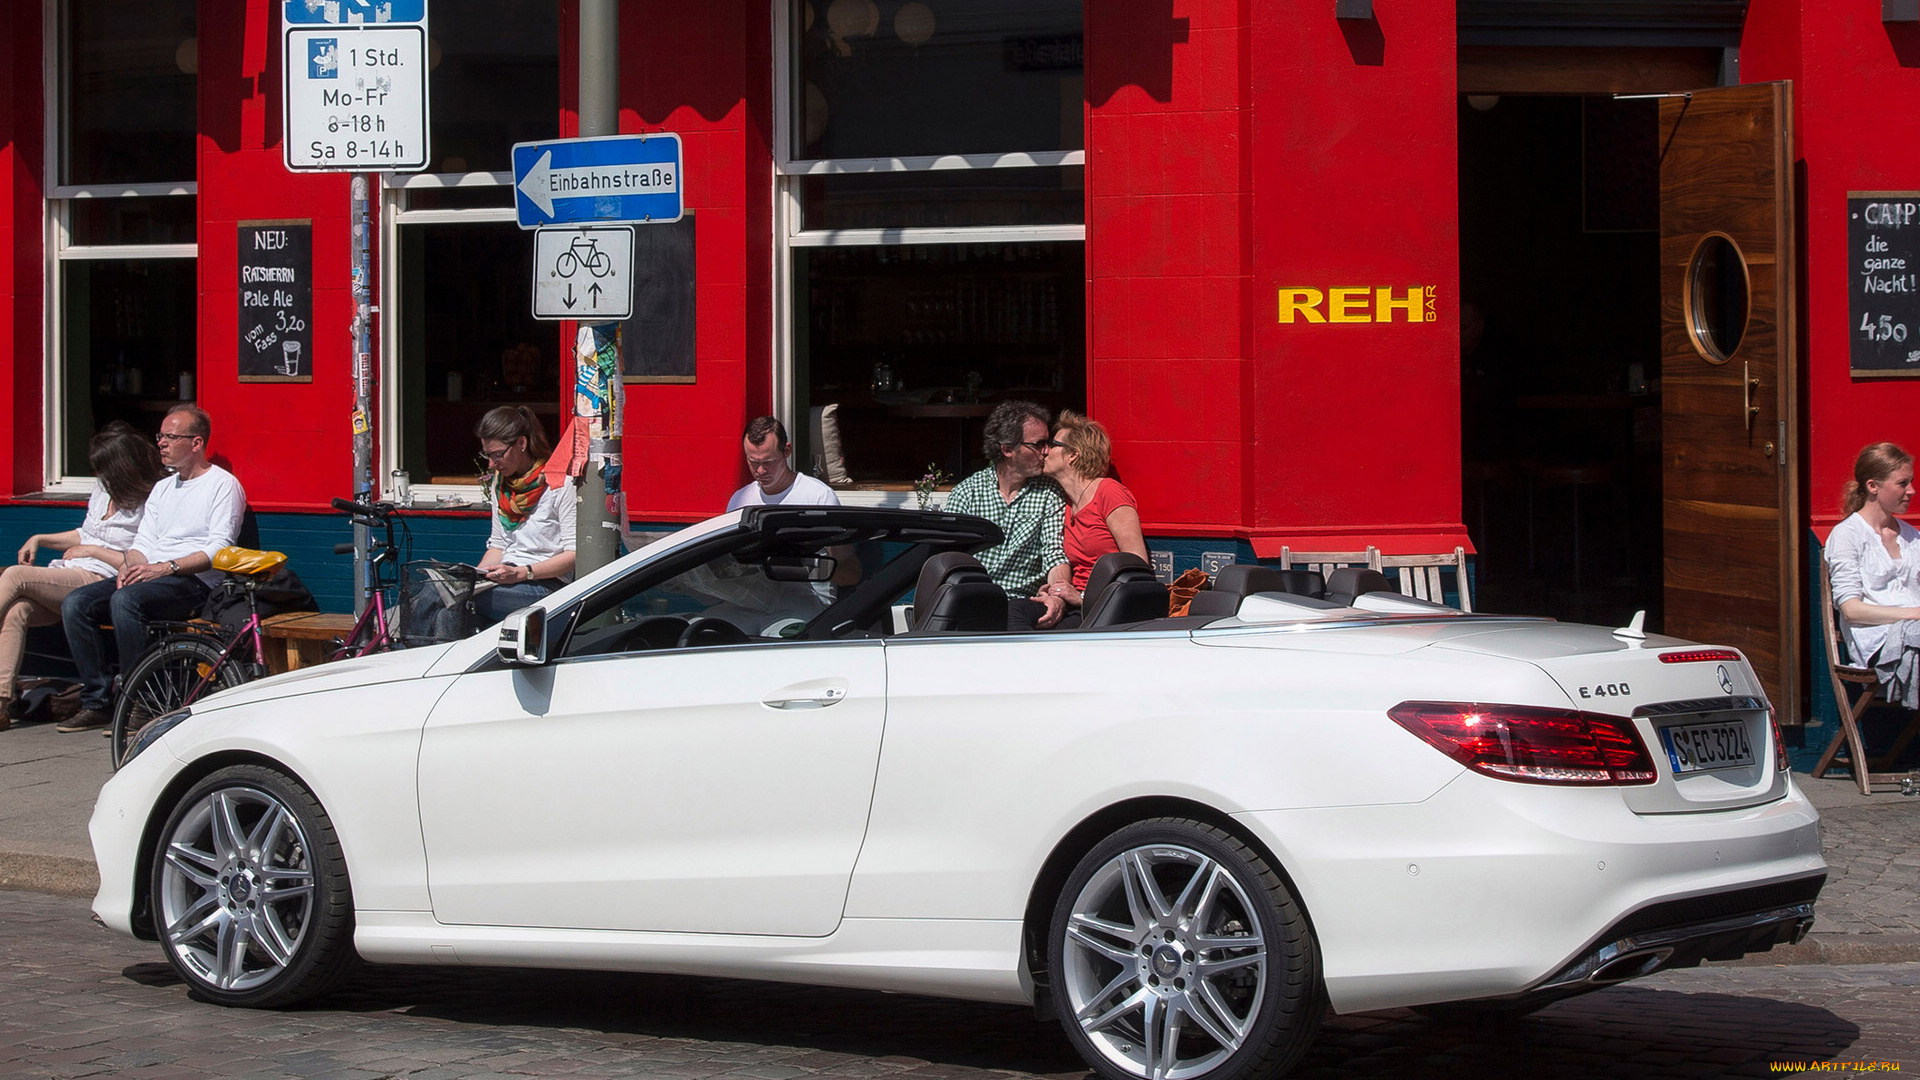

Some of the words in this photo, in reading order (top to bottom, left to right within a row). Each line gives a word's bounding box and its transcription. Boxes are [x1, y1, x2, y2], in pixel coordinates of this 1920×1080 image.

[350, 49, 356, 66] 1
[365, 48, 404, 66] Std.
[323, 89, 387, 106] Mo-Fr
[311, 141, 336, 158] Sa
[549, 168, 673, 192] Einbahnstraße
[1864, 202, 1920, 225] CAIP
[254, 231, 289, 250] NEU:
[1865, 235, 1889, 253] die
[242, 265, 295, 284] RATSHERRN
[1861, 258, 1906, 275] ganze
[1864, 274, 1916, 294] Nacht!
[243, 290, 270, 307] Pale
[273, 289, 293, 307] Ale
[1278, 285, 1424, 323] REH
[1425, 284, 1437, 322] BAR
[275, 310, 306, 334] 3,20
[1859, 312, 1908, 343] 4,50
[244, 323, 265, 343] vom
[254, 332, 278, 353] Fass
[1210, 560, 1218, 572] S
[1578, 686, 1591, 699] E
[1594, 682, 1632, 698] 400
